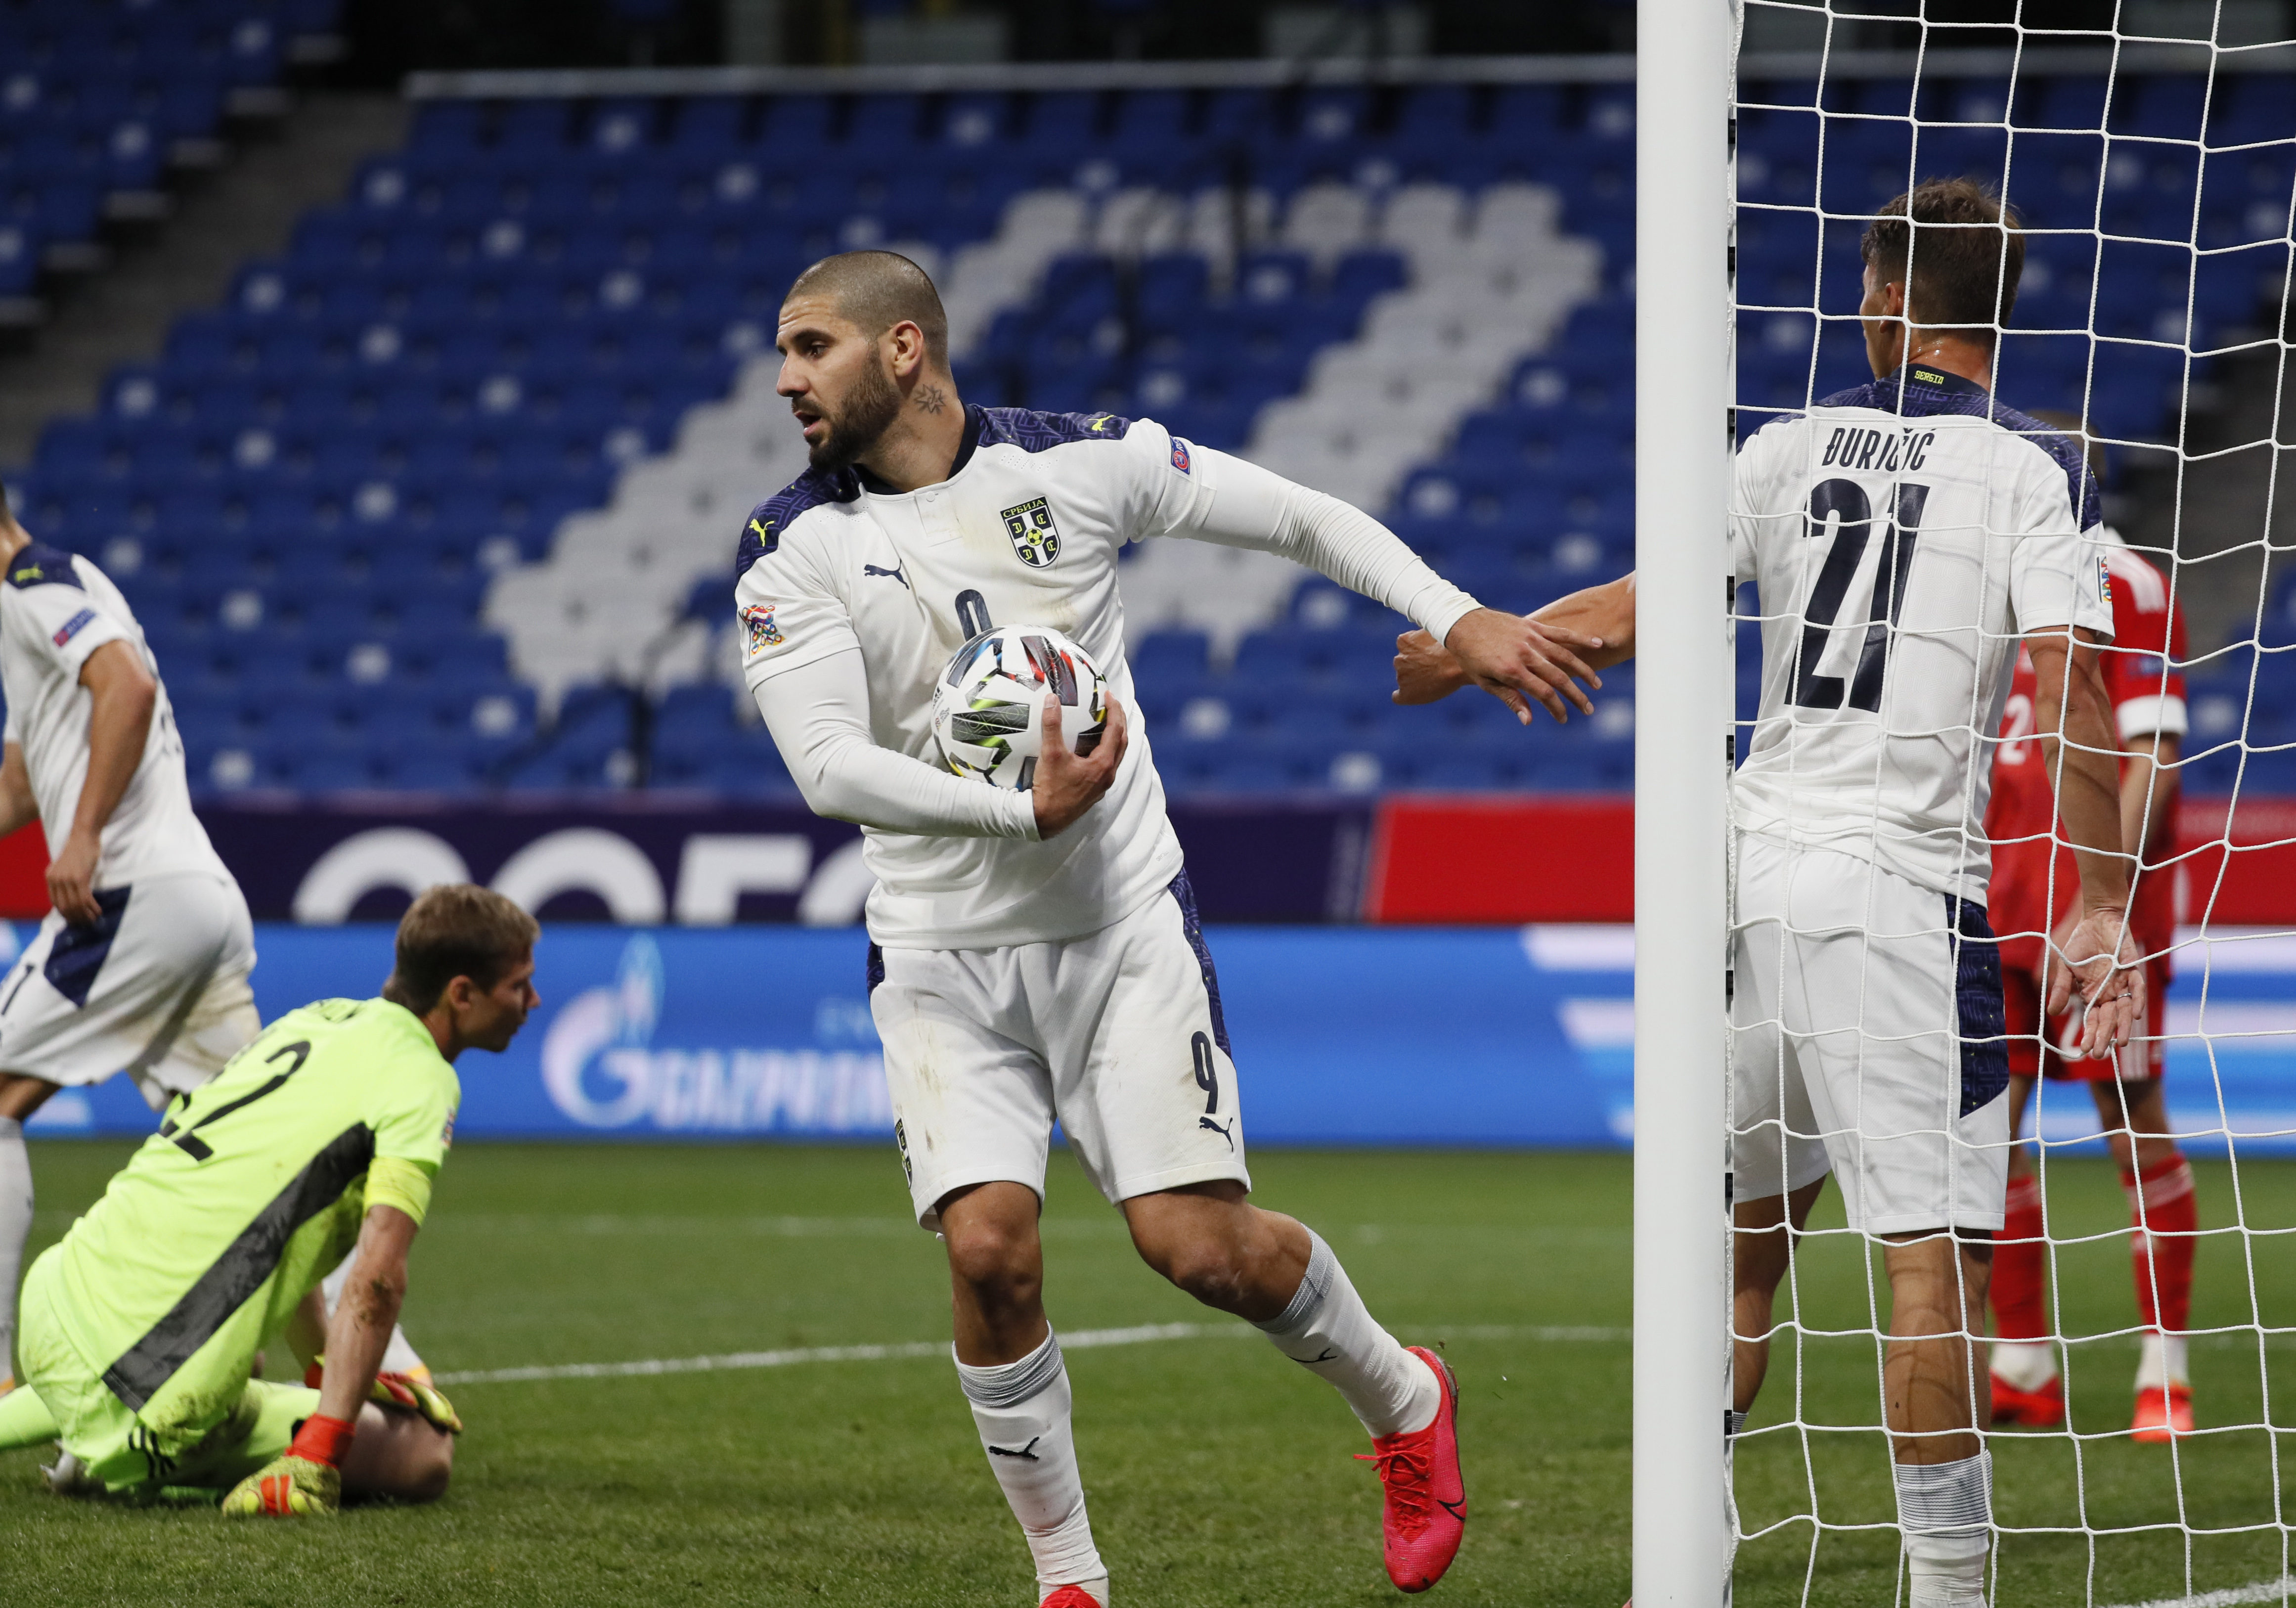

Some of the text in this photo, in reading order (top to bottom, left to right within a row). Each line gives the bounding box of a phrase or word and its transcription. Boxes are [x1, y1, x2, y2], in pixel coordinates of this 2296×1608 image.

[1003, 499, 1045, 518] СРБИЈА
[1784, 478, 1931, 714] 21
[1191, 1030, 1218, 1114] 9
